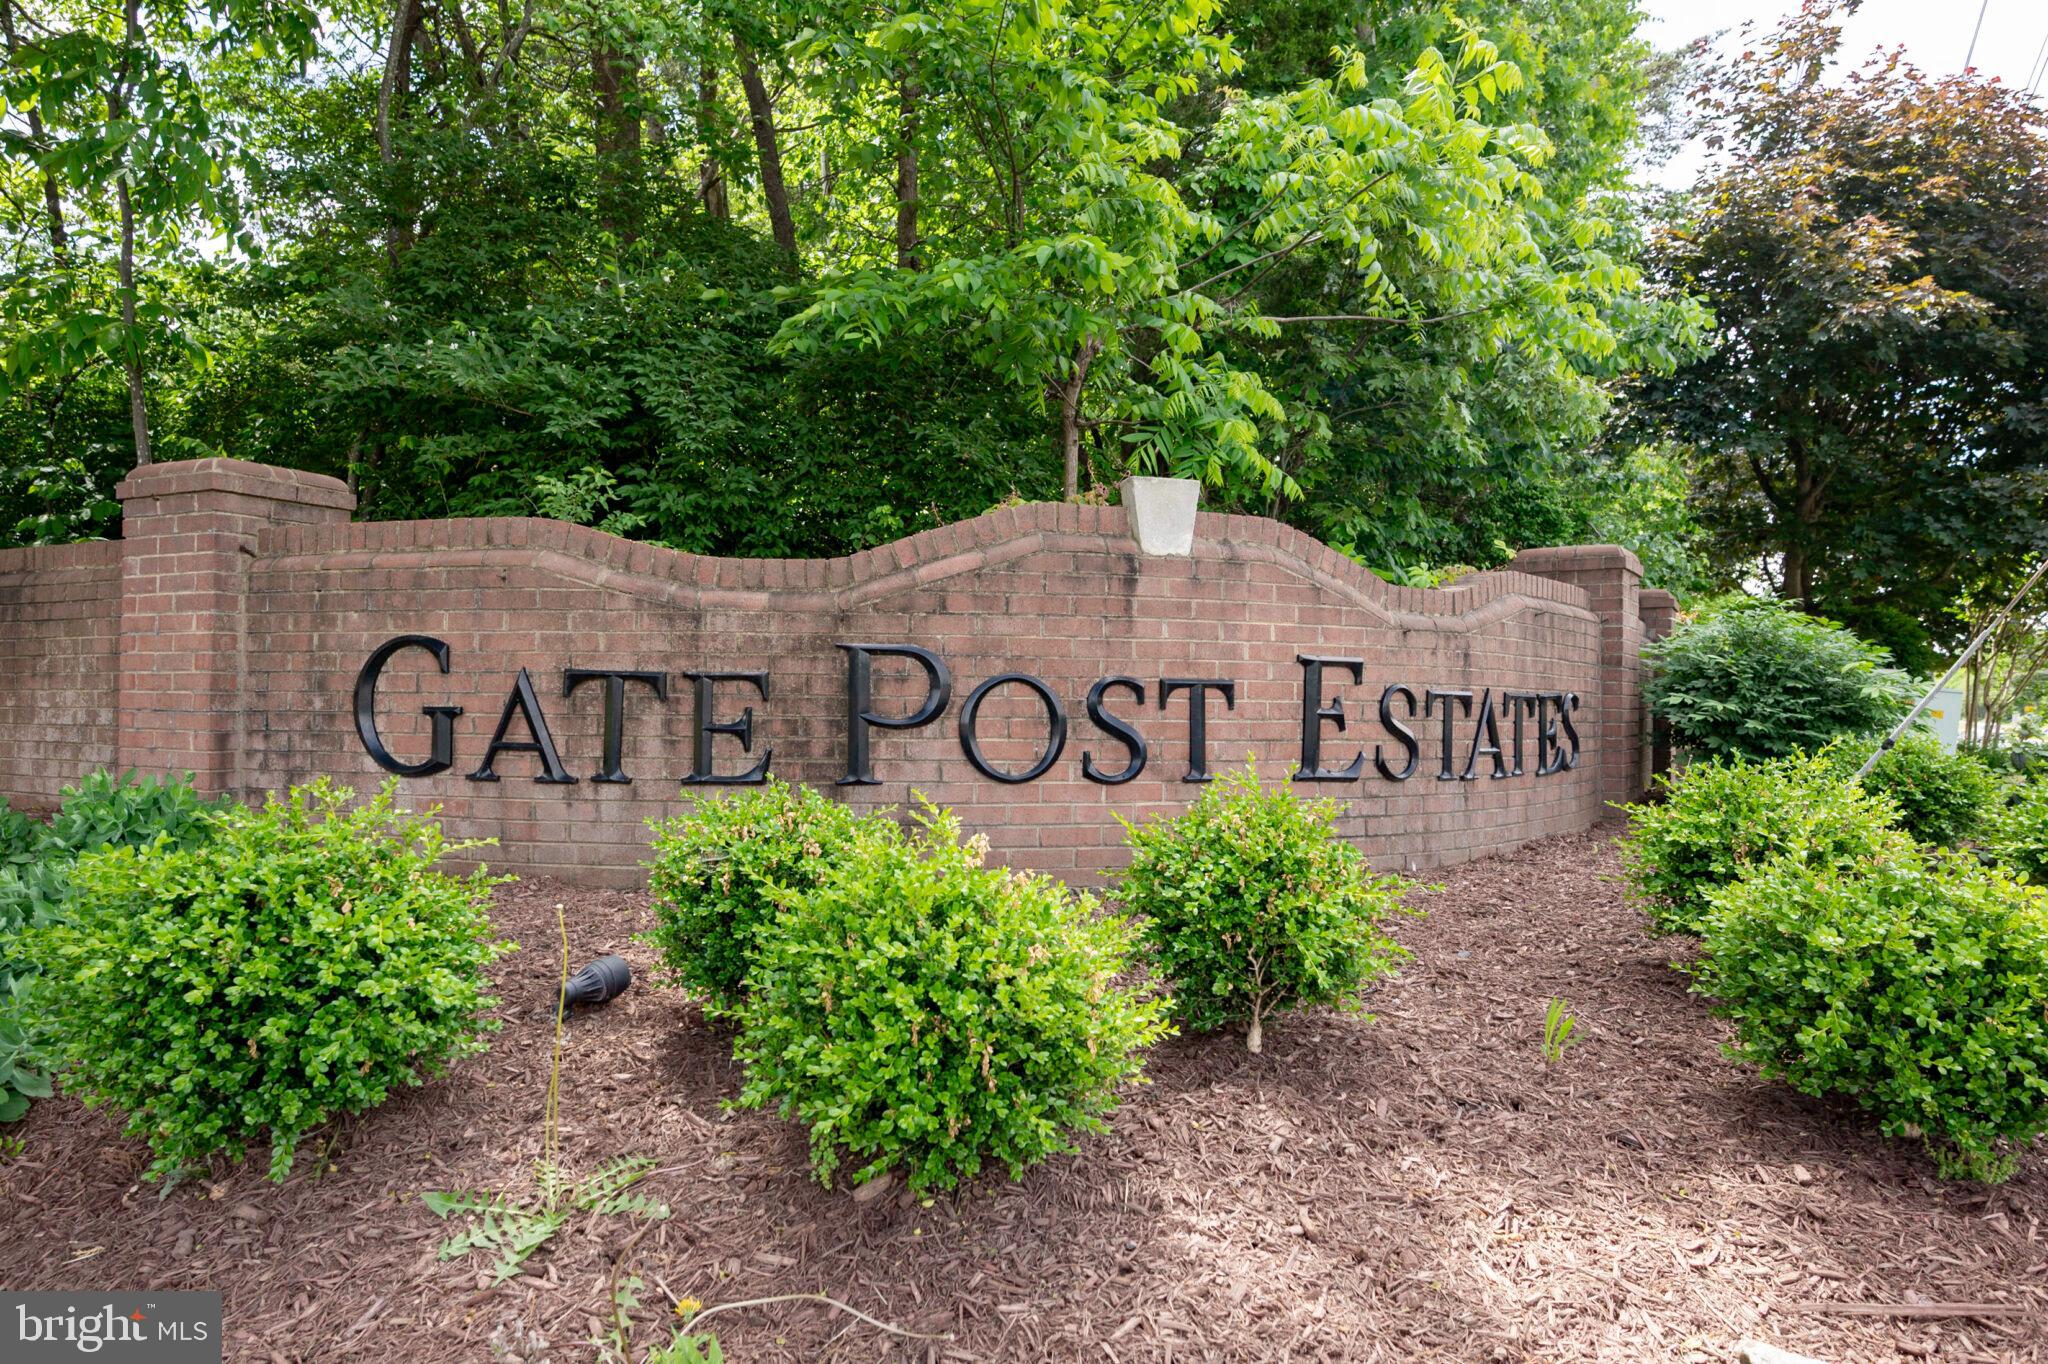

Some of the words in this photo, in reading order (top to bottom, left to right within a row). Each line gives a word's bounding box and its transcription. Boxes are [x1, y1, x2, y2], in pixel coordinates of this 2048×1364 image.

[354, 634, 772, 785] GATE
[834, 642, 1235, 785] POST
[1292, 653, 1580, 783] ESTATES
